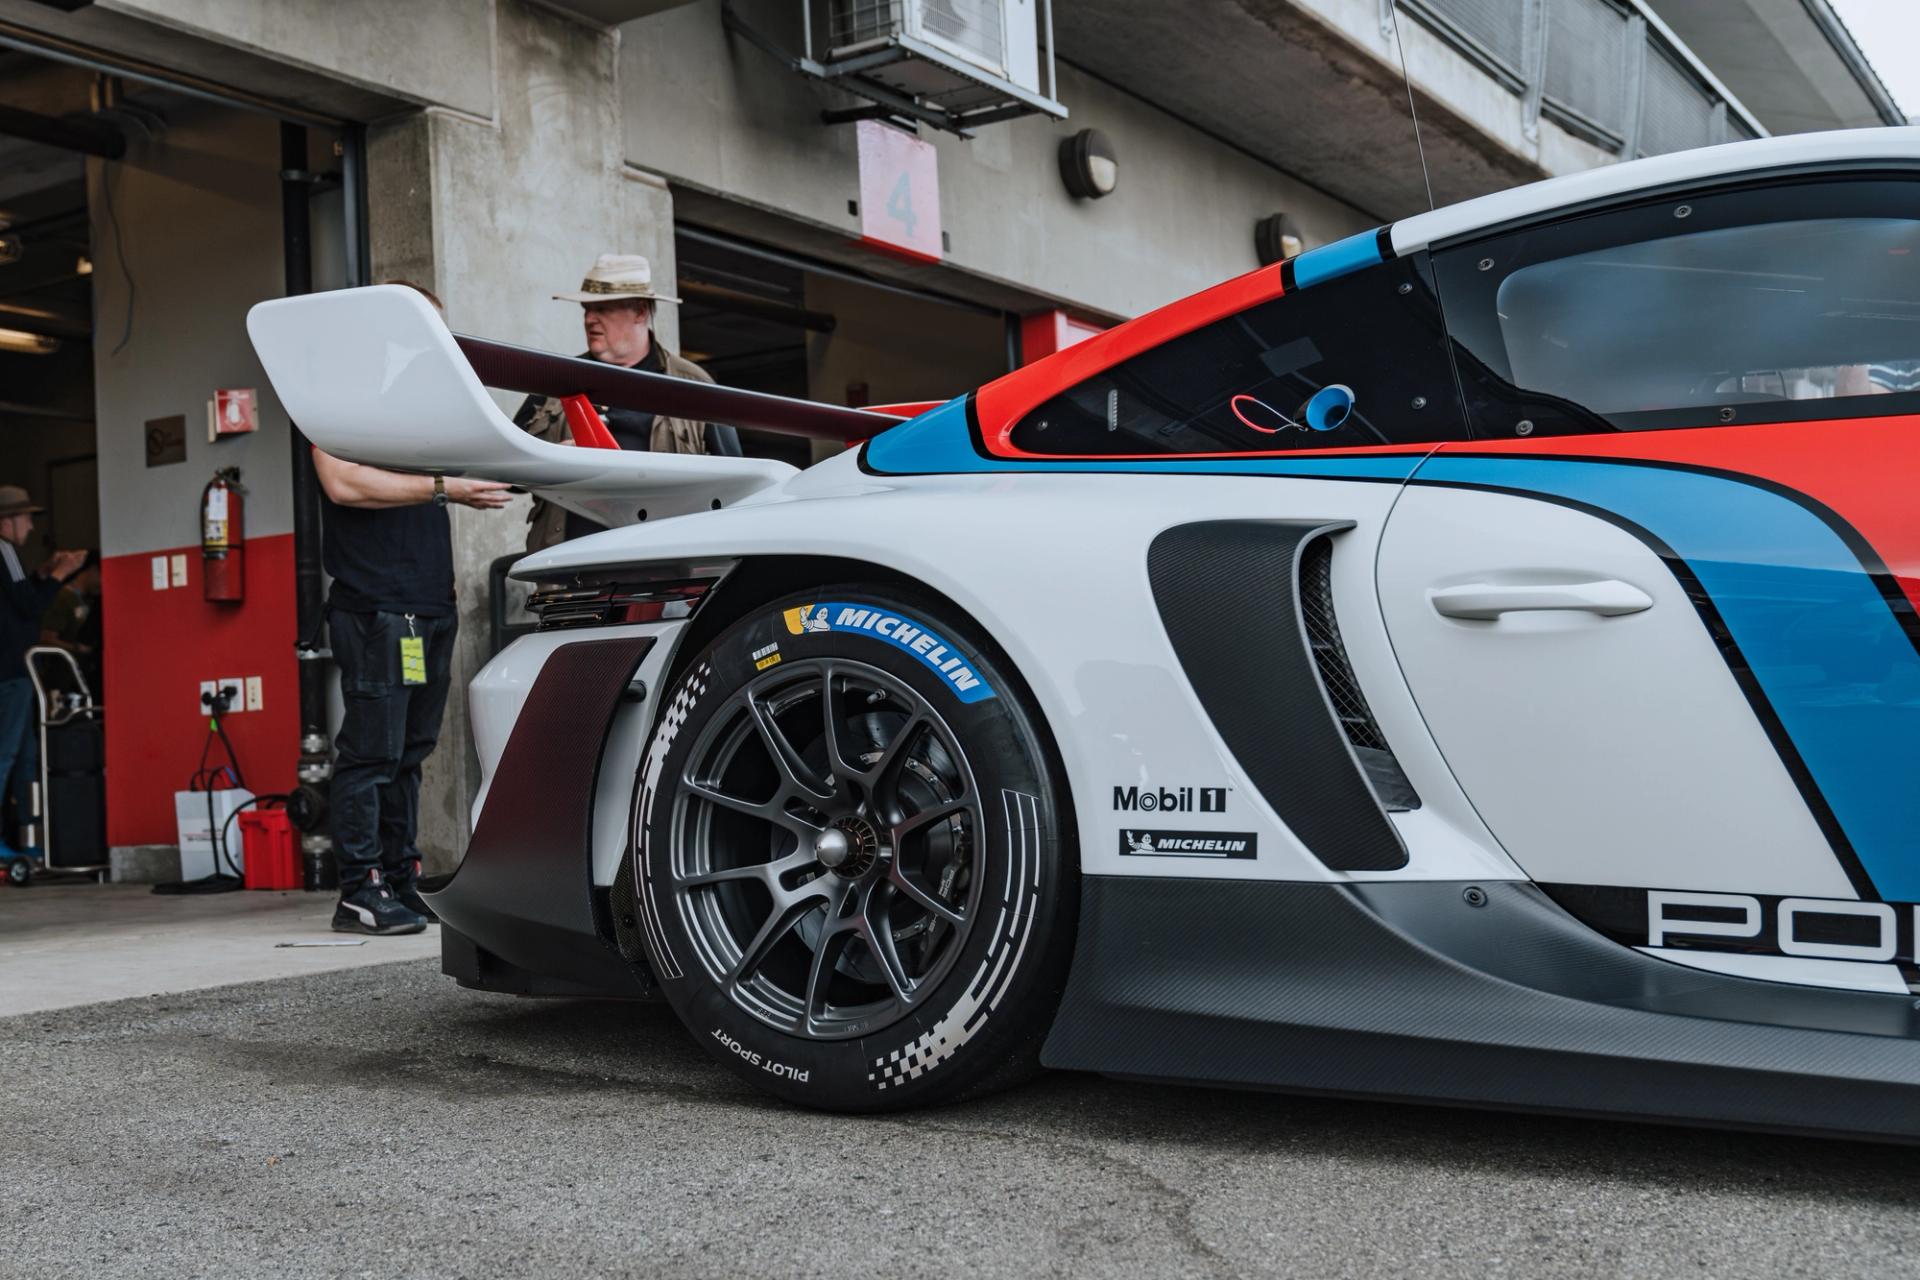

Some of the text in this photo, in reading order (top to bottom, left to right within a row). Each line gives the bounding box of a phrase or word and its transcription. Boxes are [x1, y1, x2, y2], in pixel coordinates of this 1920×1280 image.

[886, 168, 917, 237] 4
[835, 607, 981, 692] MICHELIN
[1113, 786, 1193, 812] Mobil
[1157, 838, 1247, 851] MICHELIN
[1647, 890, 1920, 964] PO
[711, 1028, 809, 1082] PILOT SPORT
